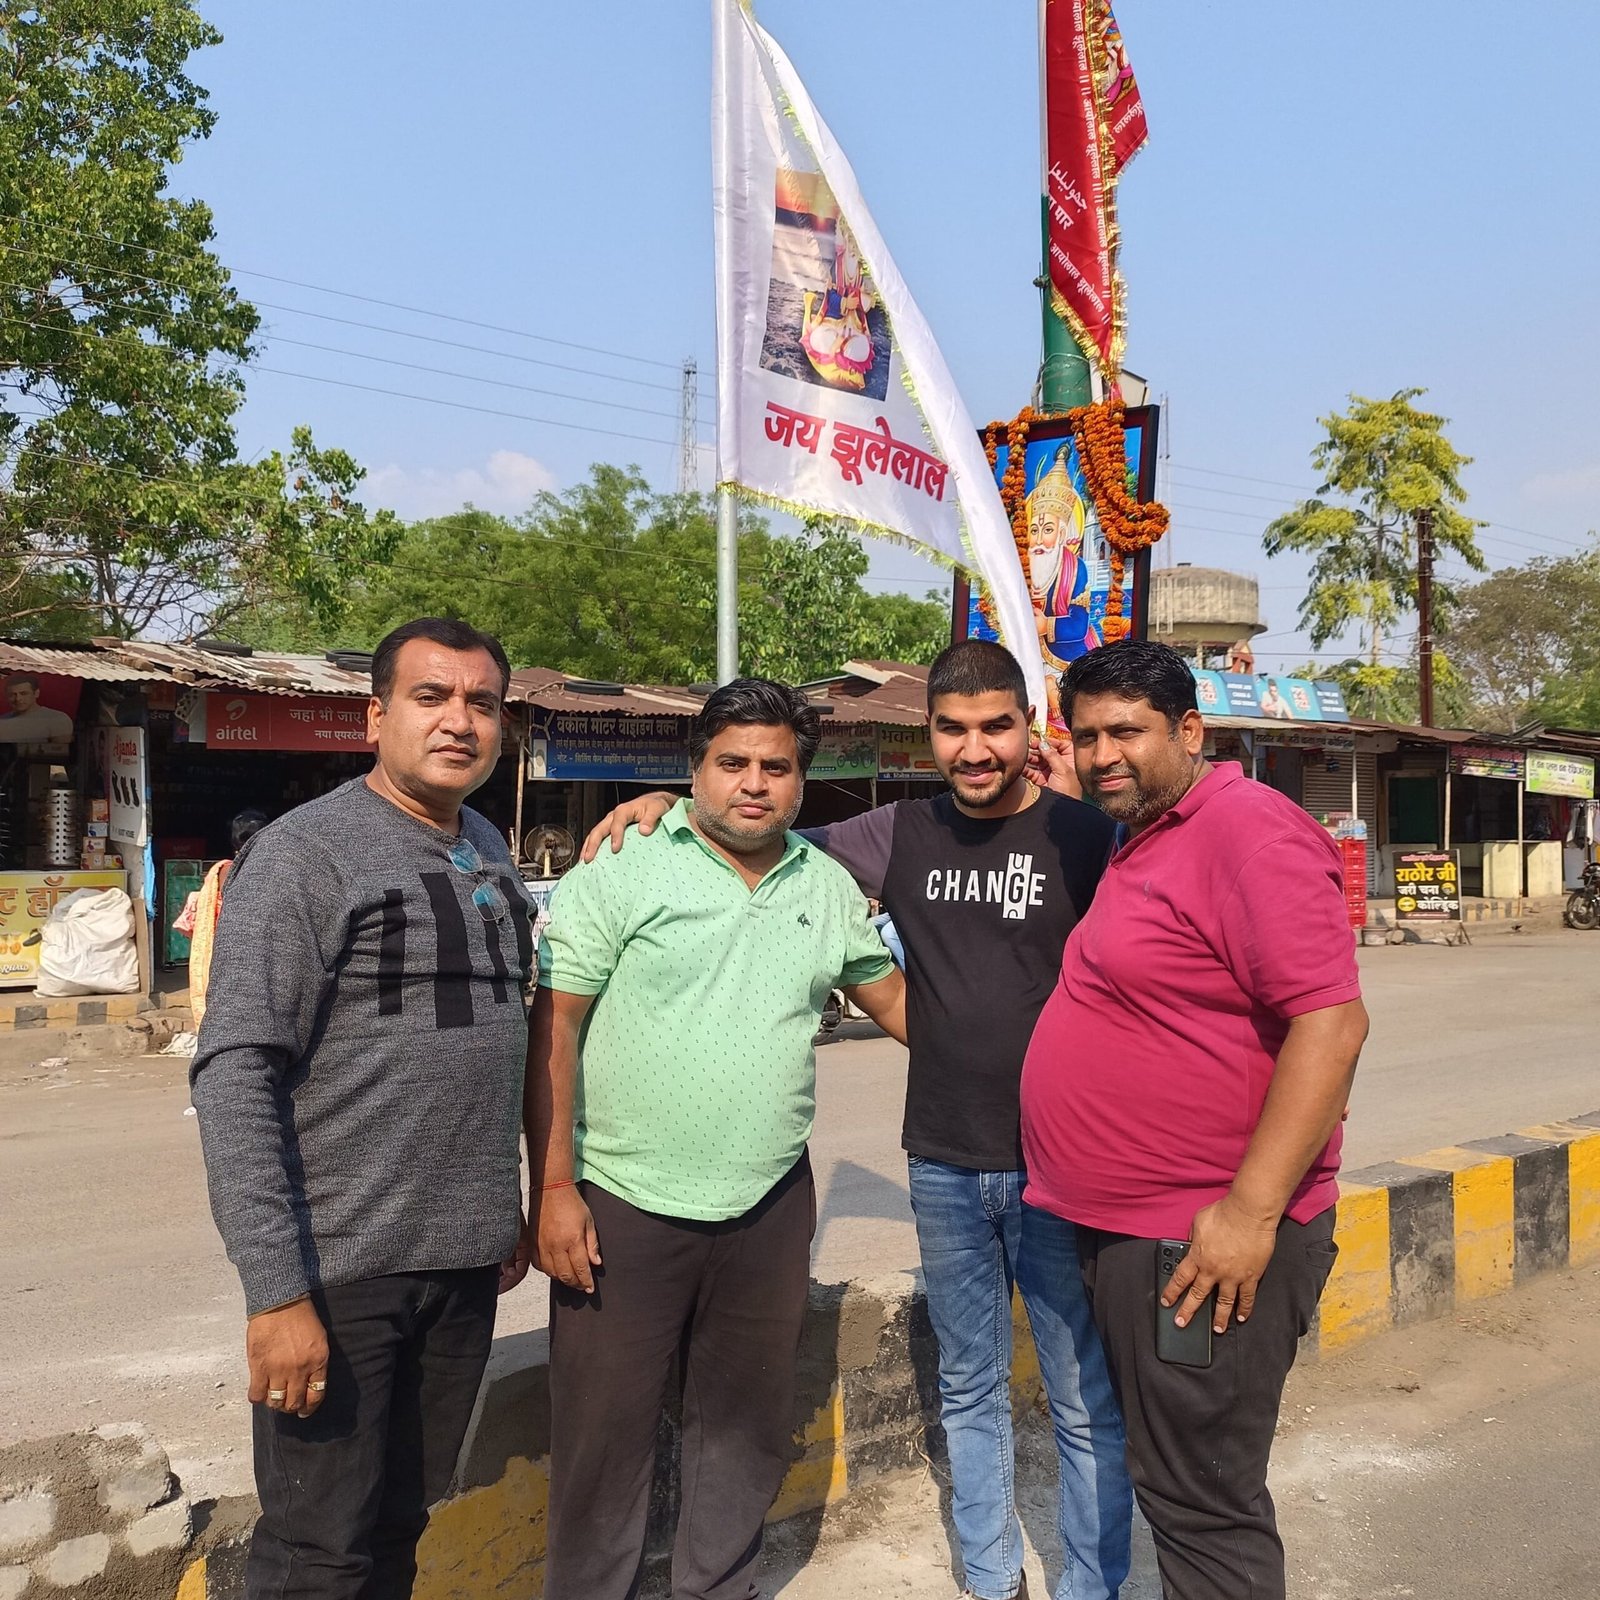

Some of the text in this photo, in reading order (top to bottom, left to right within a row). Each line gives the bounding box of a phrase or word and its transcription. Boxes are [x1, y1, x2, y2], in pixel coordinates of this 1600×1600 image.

[1054, 205, 1074, 231] पार
[1077, 277, 1105, 313] झूलेलाल
[764, 400, 949, 502] जय झूलेलाल
[319, 706, 333, 721] भी
[216, 725, 258, 741] airtel
[314, 730, 332, 739] नया
[881, 729, 915, 744] भवन
[1395, 861, 1456, 882] राठौर जी
[926, 865, 1046, 908] CHANGE
[1418, 885, 1439, 895] चना
